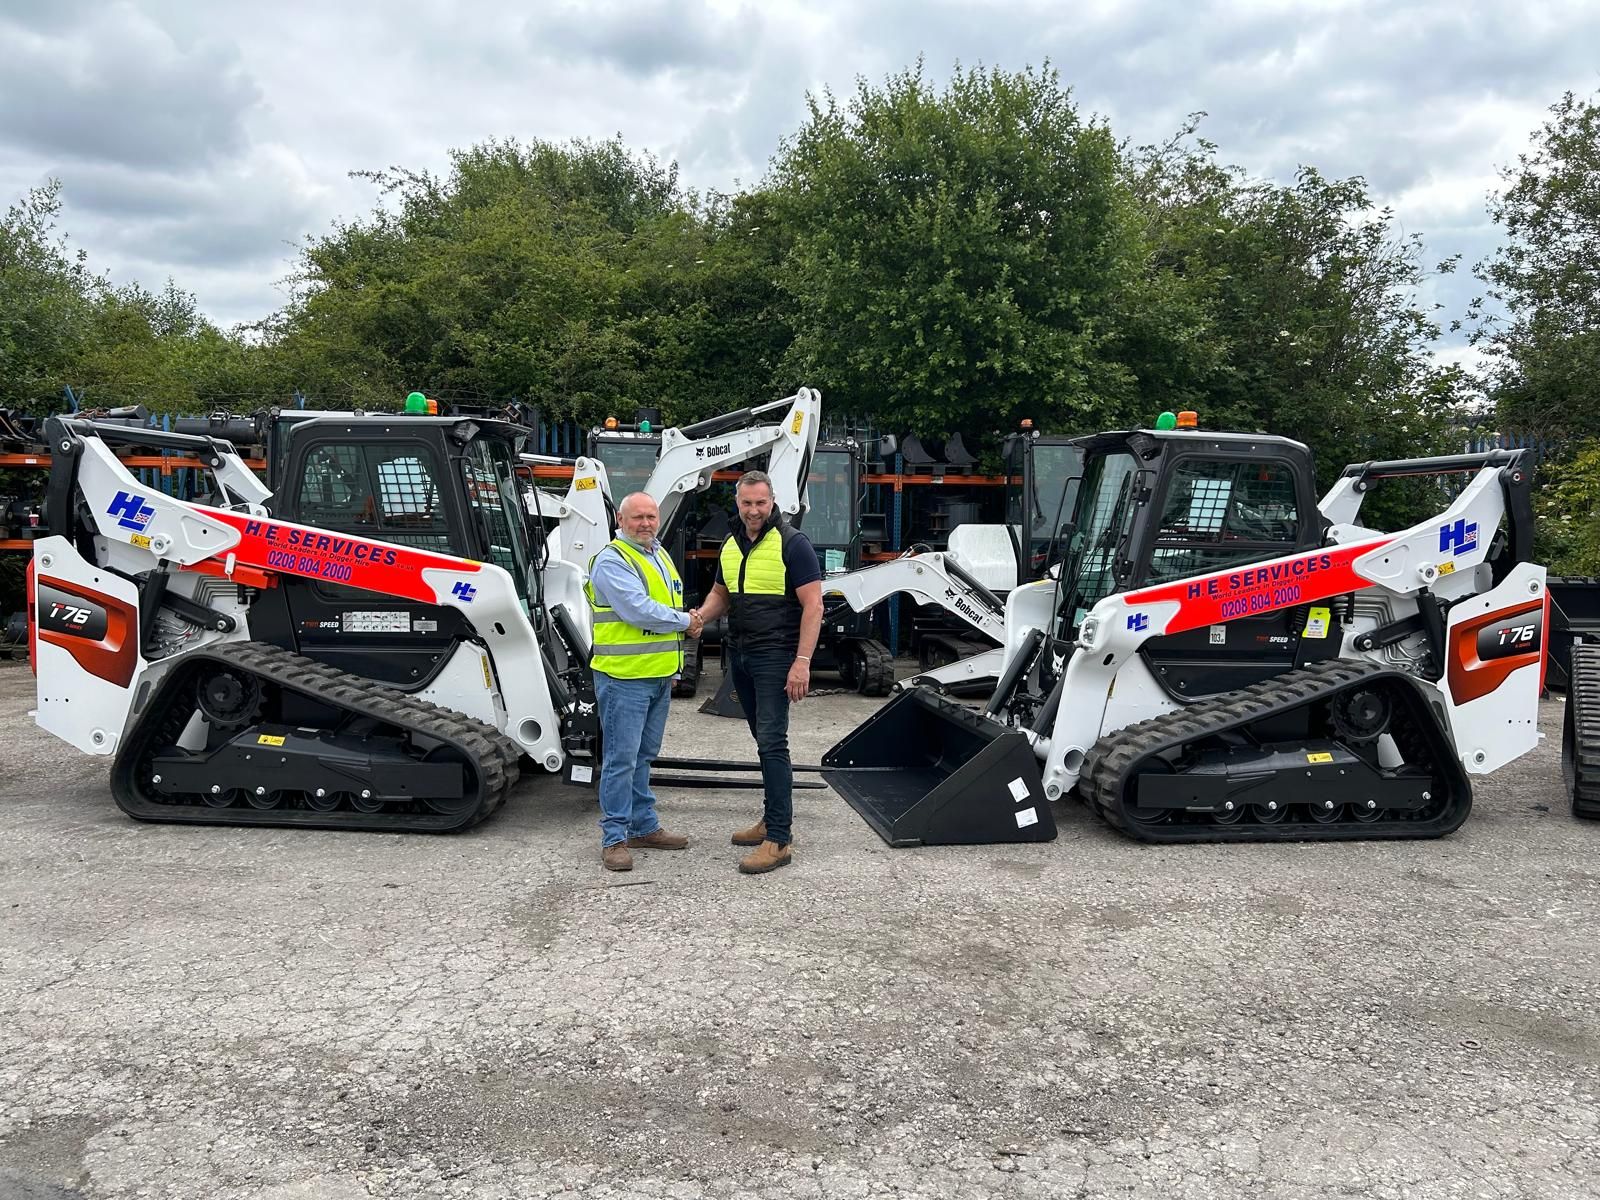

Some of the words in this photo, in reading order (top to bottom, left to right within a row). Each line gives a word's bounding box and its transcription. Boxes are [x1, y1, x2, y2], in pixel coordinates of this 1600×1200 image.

[706, 443, 731, 458] Bobcat
[245, 521, 280, 541] H.E.
[288, 529, 399, 566] SERVICES
[267, 540, 288, 549] World
[289, 545, 318, 556] Leaders
[329, 552, 353, 563] Digger
[354, 558, 370, 567] Hire
[267, 550, 295, 570] 0208
[298, 556, 320, 574] 804
[322, 561, 352, 581] 2000
[1188, 579, 1223, 600] H.E.
[1229, 554, 1332, 590] SERVICES
[1212, 592, 1232, 601] World
[1233, 586, 1261, 596] Leaders
[1271, 579, 1294, 588] Digger
[1221, 600, 1248, 618] 0208
[1251, 592, 1271, 612] 804
[1274, 585, 1300, 606] 2000
[49, 602, 93, 624] T76
[954, 597, 984, 625] Bobcat
[1498, 624, 1536, 645] T76
